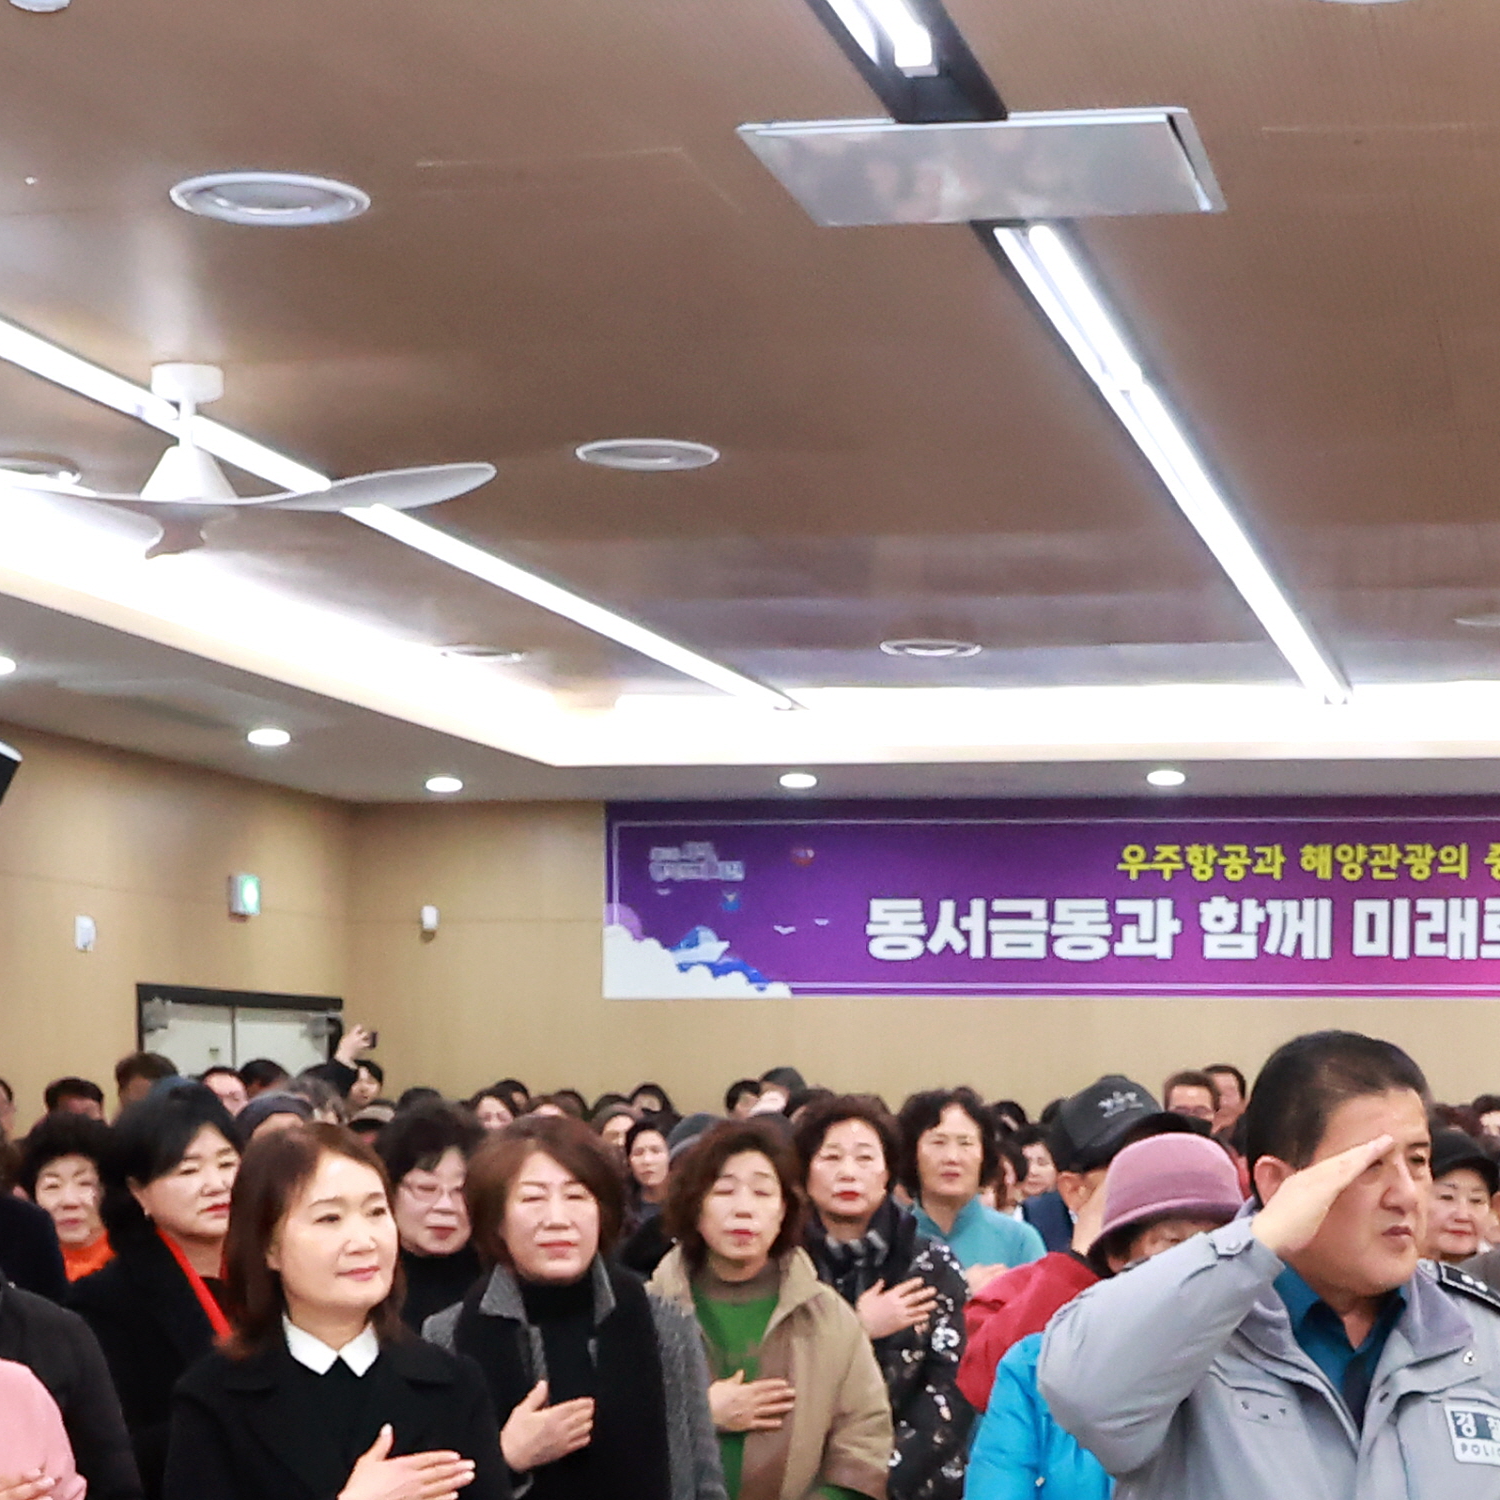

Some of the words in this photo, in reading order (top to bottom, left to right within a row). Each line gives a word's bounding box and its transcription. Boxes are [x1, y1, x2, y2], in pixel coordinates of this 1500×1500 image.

[1116, 843, 1287, 882] 우주항공과
[1299, 843, 1469, 882] 해양관광의
[865, 897, 1183, 961] 동서금동과
[1199, 896, 1333, 961] 함께
